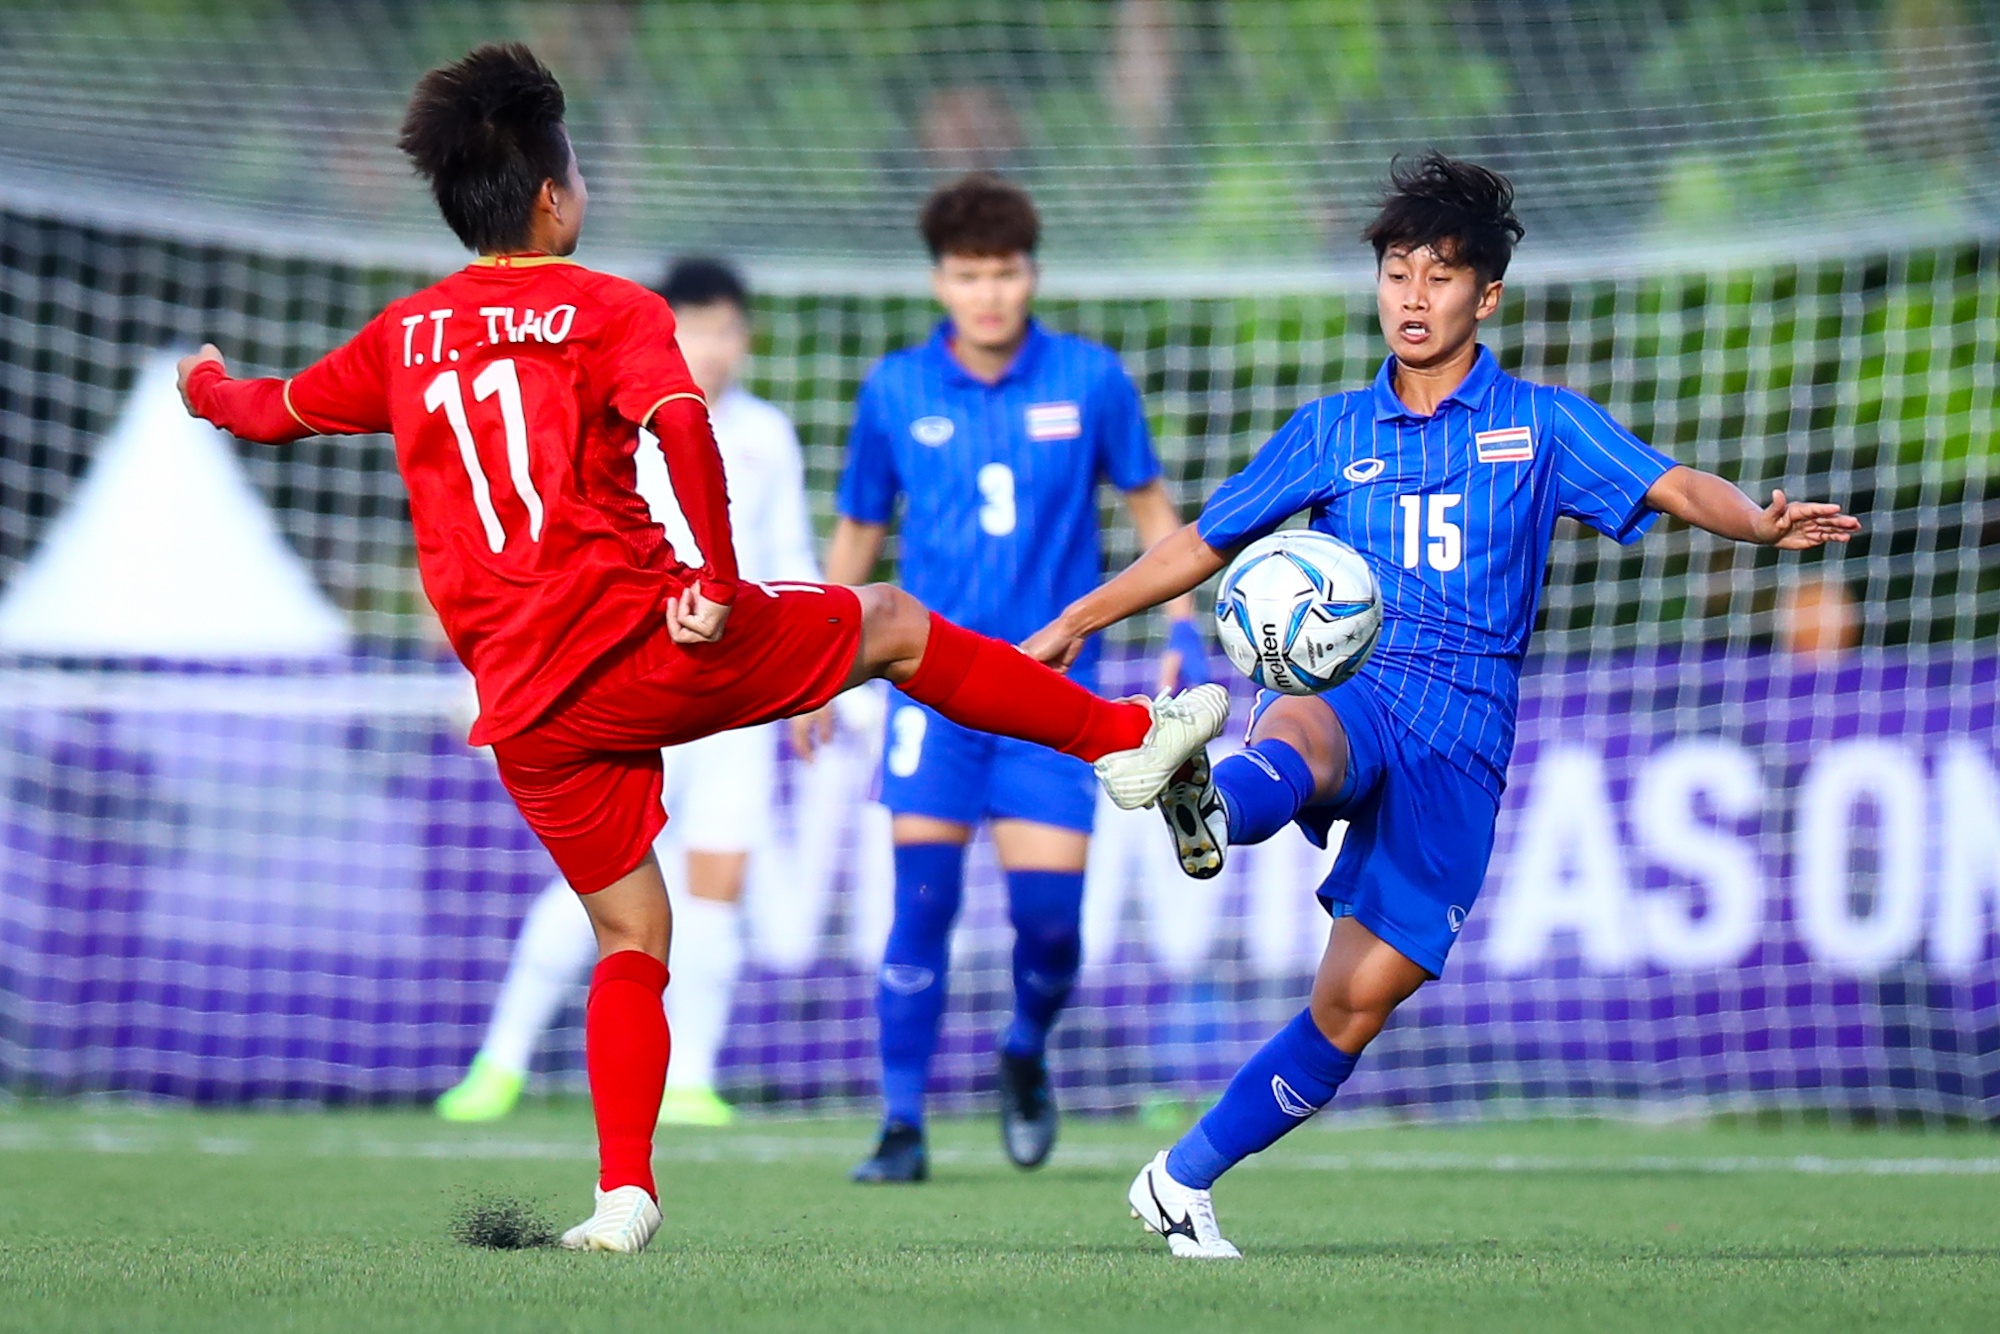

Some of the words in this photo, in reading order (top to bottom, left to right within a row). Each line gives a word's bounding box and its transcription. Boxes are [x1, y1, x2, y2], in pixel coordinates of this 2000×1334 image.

[424, 358, 543, 554] 11
[977, 462, 1016, 537] 3
[1400, 494, 1461, 572] 15
[1262, 623, 1293, 688] molten
[888, 705, 928, 778] 3
